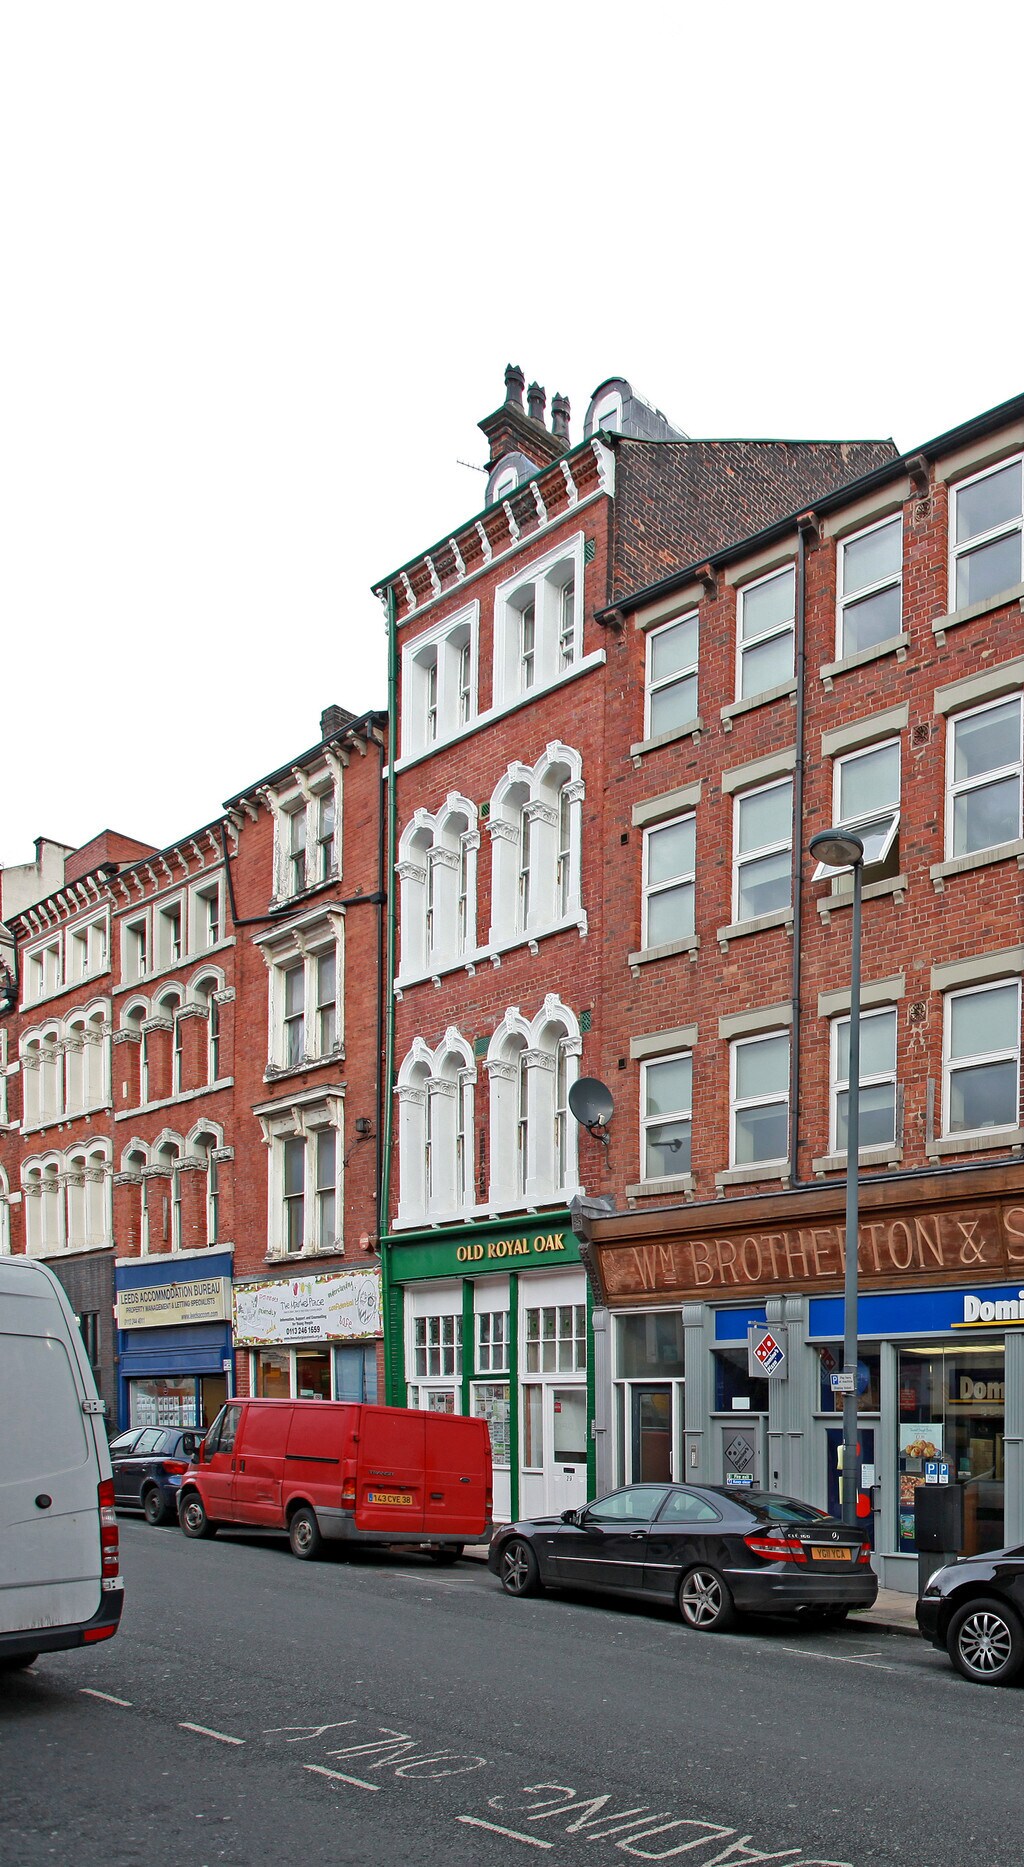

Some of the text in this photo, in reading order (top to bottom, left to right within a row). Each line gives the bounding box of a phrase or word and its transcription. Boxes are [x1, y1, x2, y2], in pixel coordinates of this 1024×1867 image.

[456, 1233, 565, 1261] OLD ROYAL OAK
[689, 1215, 946, 1286] BROTHERTON
[958, 1220, 987, 1264] &
[120, 1282, 220, 1304] LEEDS ACCOMMODATION BUREAU
[832, 1376, 838, 1384] P
[928, 1464, 935, 1474] P
[941, 1465, 946, 1474] P
[833, 1549, 845, 1558] YCA
[263, 1719, 488, 1779] ONLY
